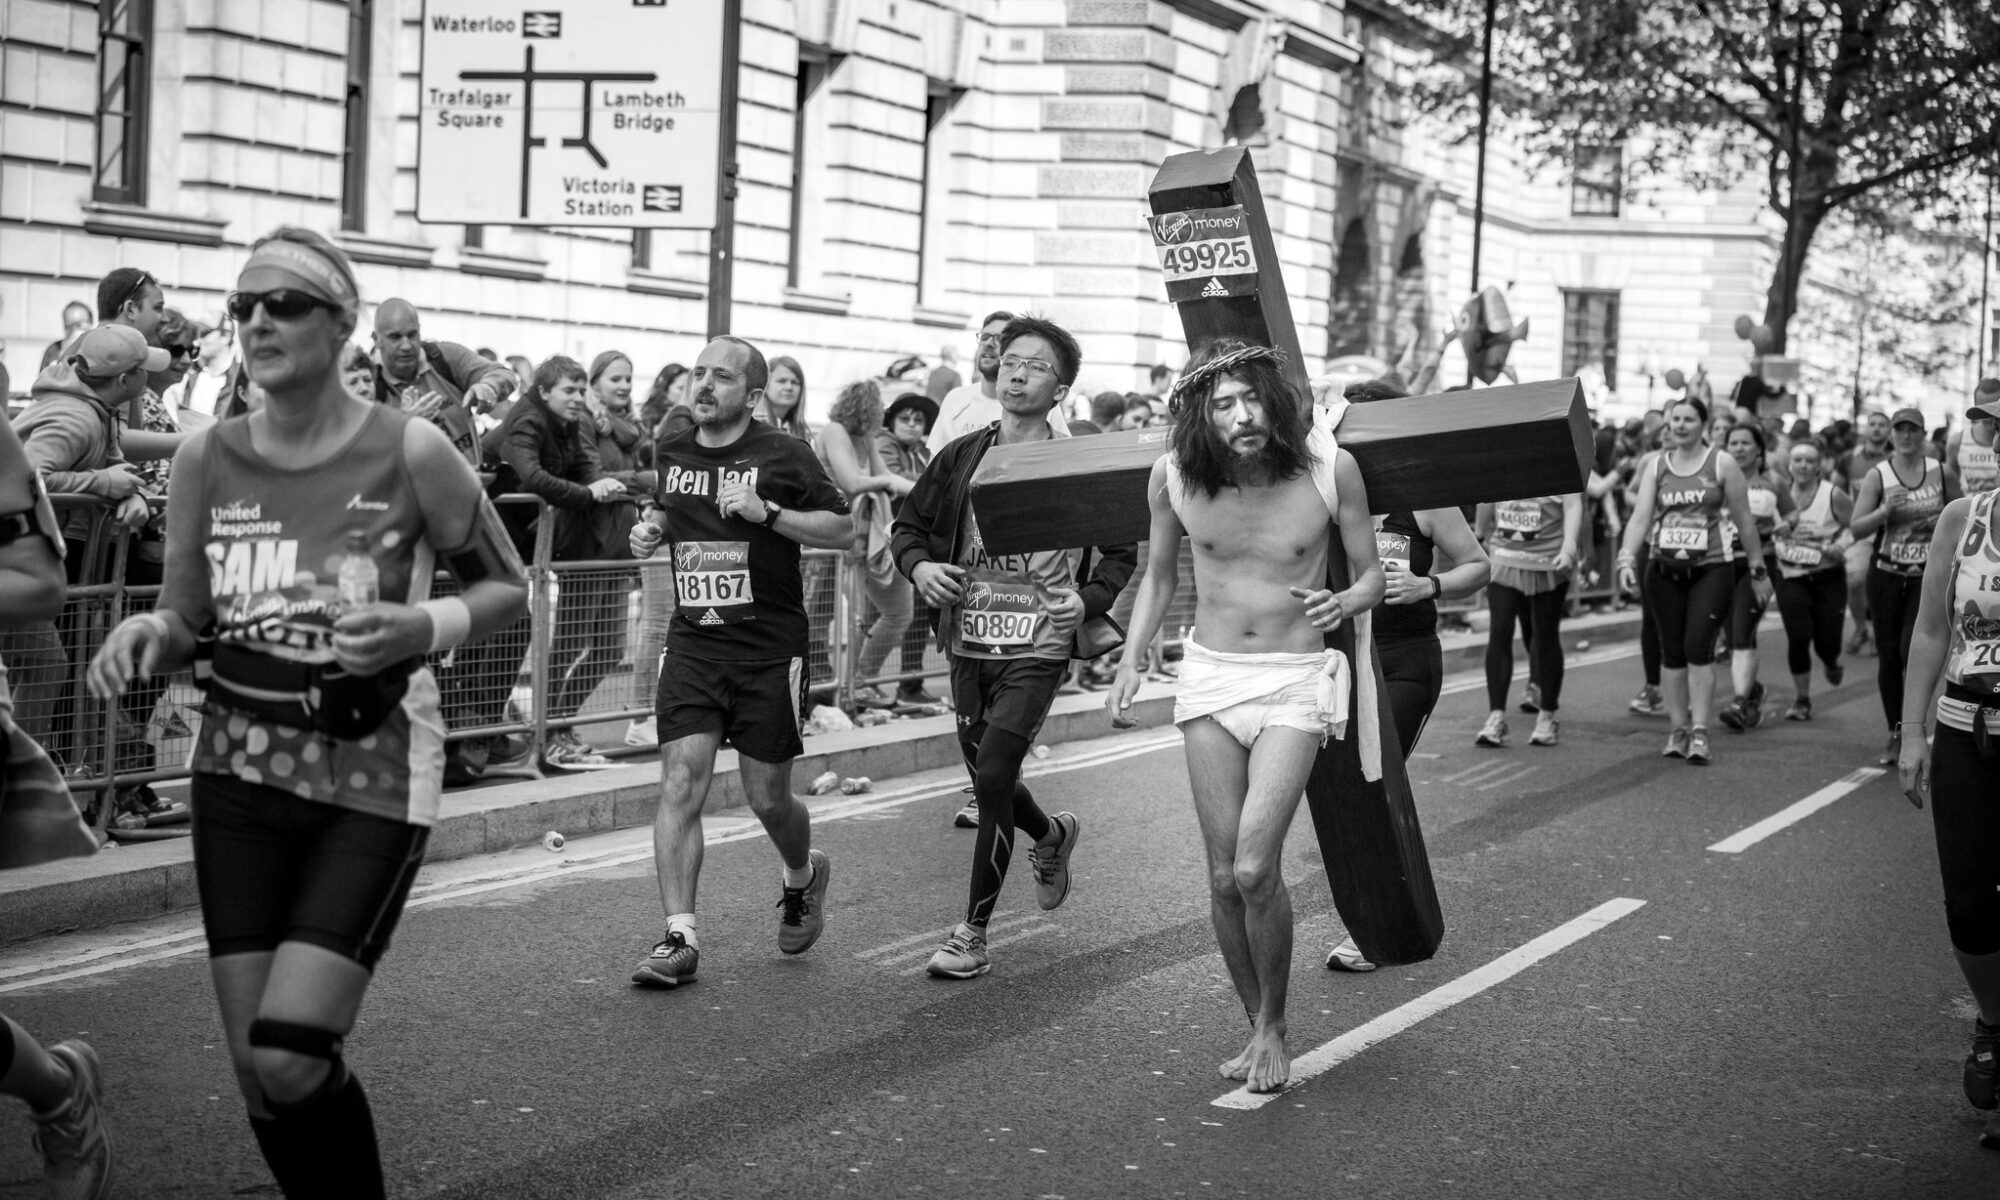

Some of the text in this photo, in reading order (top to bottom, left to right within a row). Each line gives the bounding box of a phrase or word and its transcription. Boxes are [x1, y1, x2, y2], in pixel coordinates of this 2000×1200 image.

[431, 16, 516, 33] Waterloo
[429, 88, 512, 109] Trafalgar
[603, 90, 686, 108] Lambeth
[437, 111, 504, 129] Square
[613, 113, 675, 133] Bridge
[562, 177, 636, 194] Victoria
[564, 199, 634, 216] Station
[1157, 214, 1241, 243] Virgin money
[1162, 240, 1252, 275] 49925
[1201, 288, 1230, 298] adidas
[665, 465, 710, 496] Ben
[1661, 489, 1706, 507] MARY
[211, 503, 262, 523] United
[211, 520, 283, 538] Response
[1665, 530, 1702, 545] 3327
[1376, 541, 1407, 552] oney
[703, 551, 744, 562] money
[204, 539, 299, 598] SAM
[679, 573, 746, 601] 18167
[993, 592, 1034, 606] money
[700, 618, 725, 626] adidas
[961, 612, 1033, 639] 50890
[1964, 703, 1999, 717] Cacer
